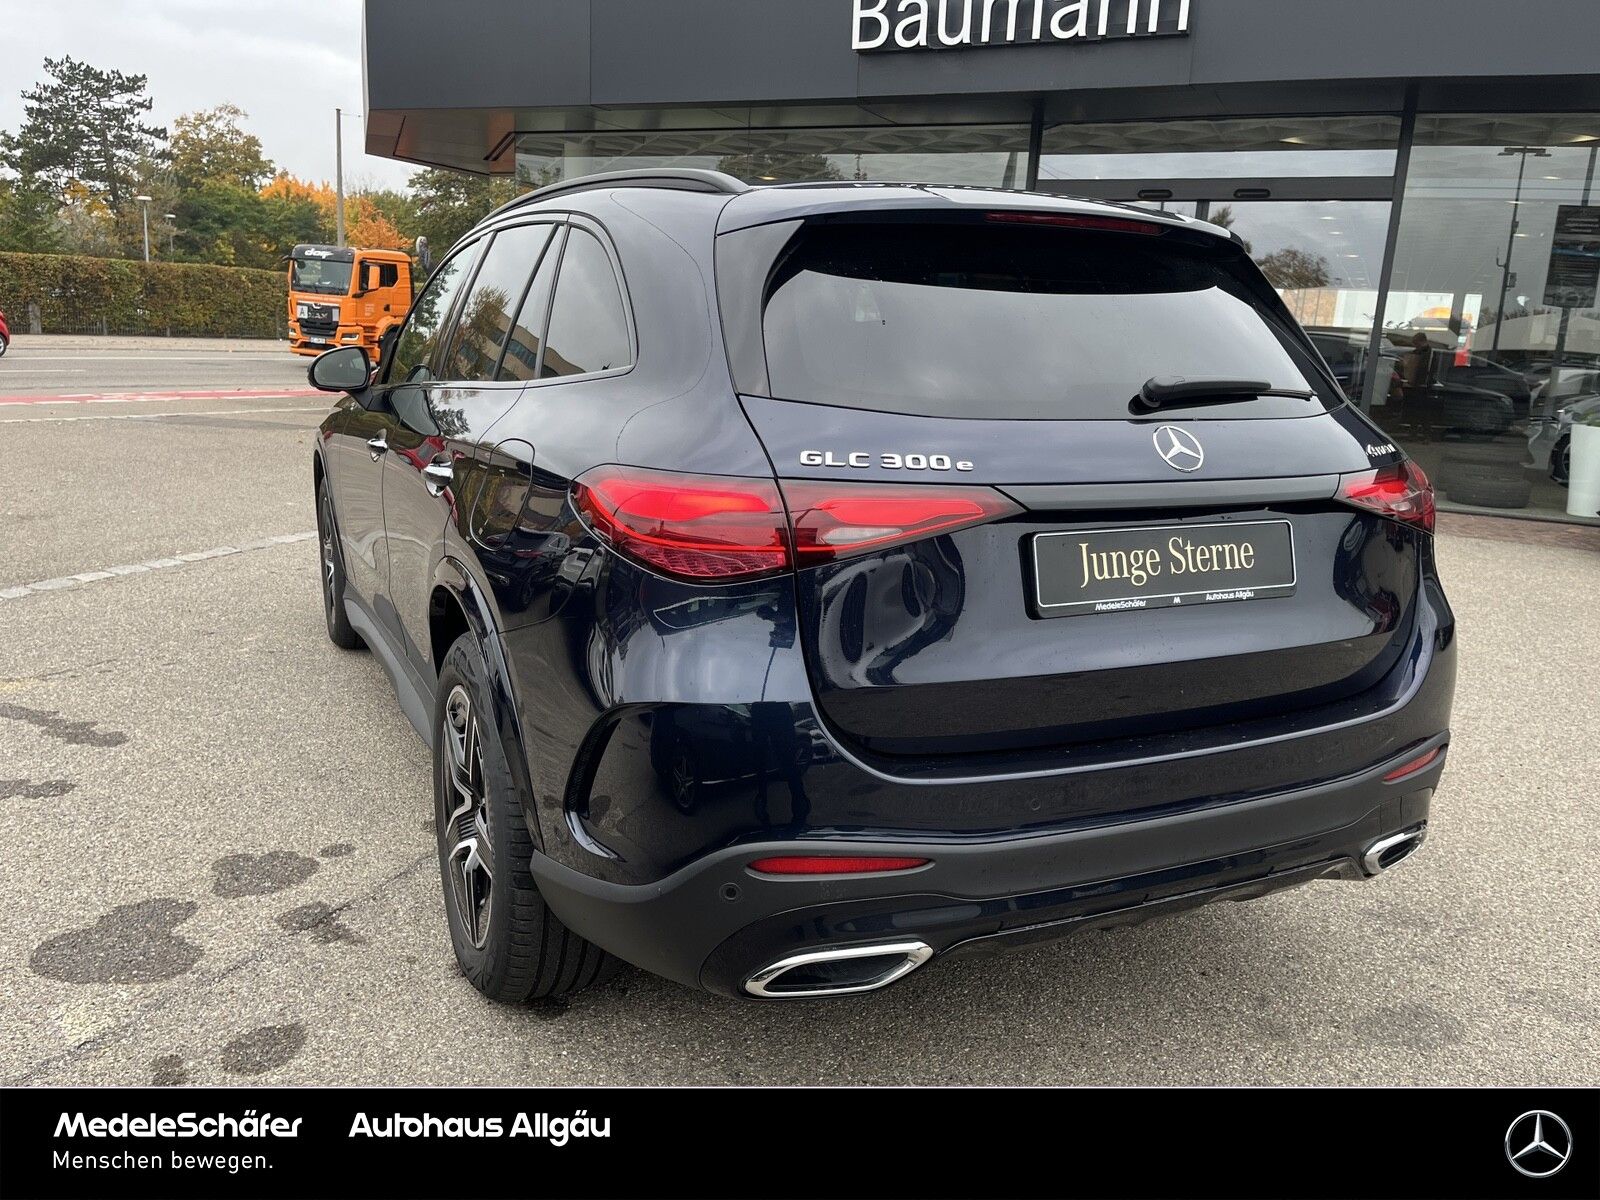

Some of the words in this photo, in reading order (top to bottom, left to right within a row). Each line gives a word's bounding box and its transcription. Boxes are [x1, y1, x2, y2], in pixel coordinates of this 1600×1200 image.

[852, 0, 1190, 50] Baumann
[800, 450, 870, 468] GLC
[1079, 542, 1161, 588] Junge
[1168, 536, 1255, 575] Sterne
